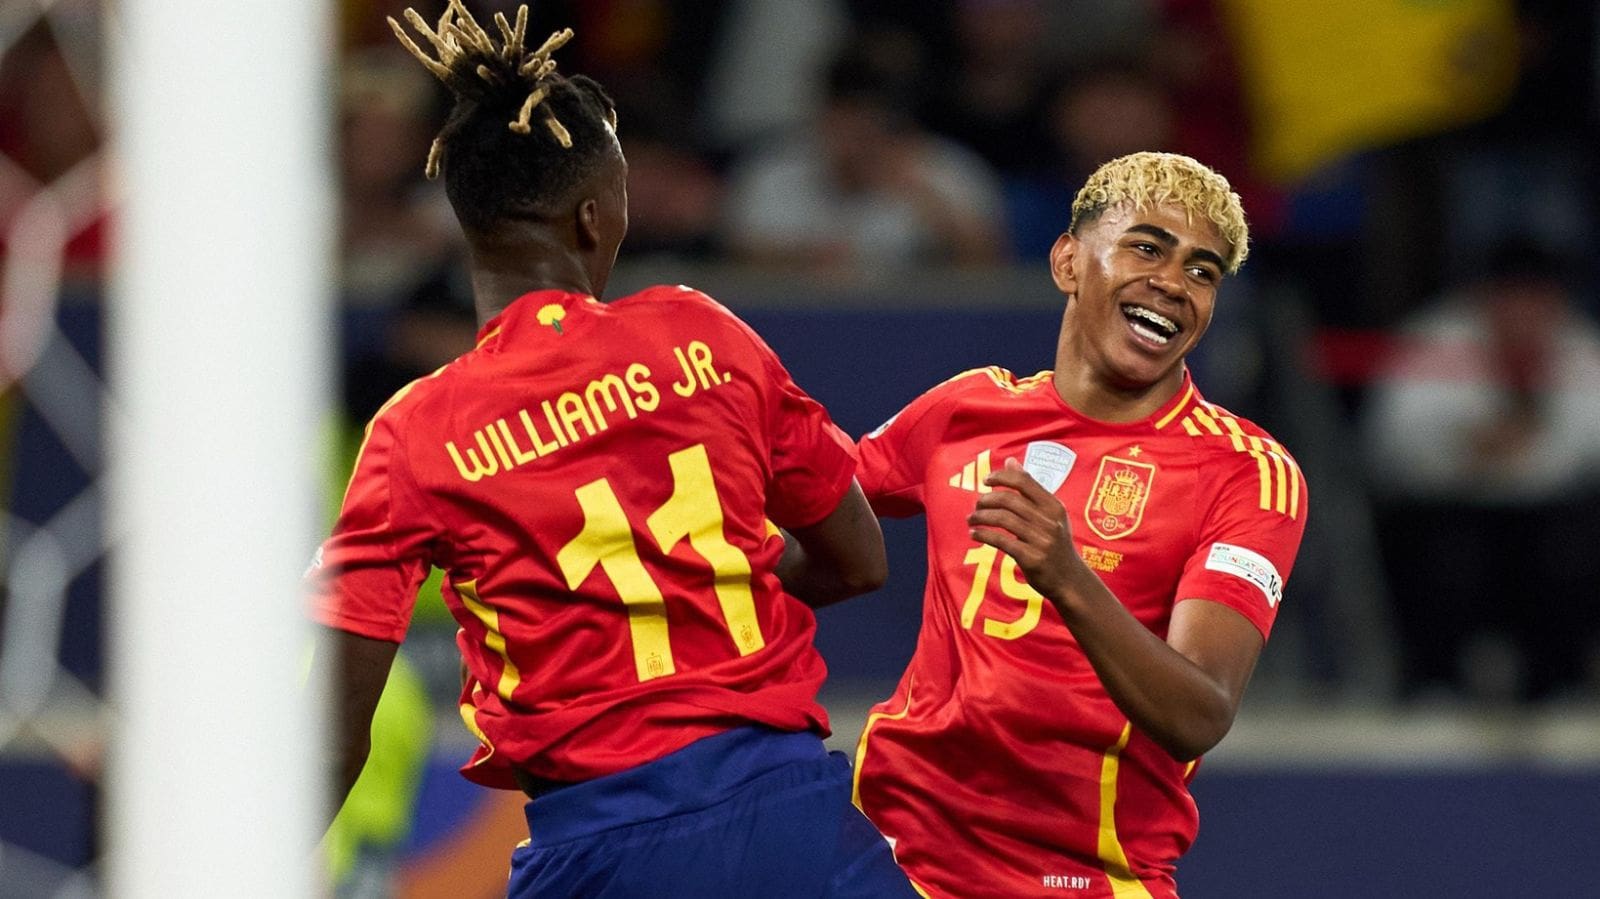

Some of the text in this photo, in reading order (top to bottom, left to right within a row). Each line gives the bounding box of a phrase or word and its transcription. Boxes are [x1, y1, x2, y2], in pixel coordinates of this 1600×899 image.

[445, 340, 731, 482] WILLIAMS JR.
[556, 443, 765, 683] 11
[960, 543, 1044, 640] 19
[1043, 875, 1091, 890] HEAT.RDY
